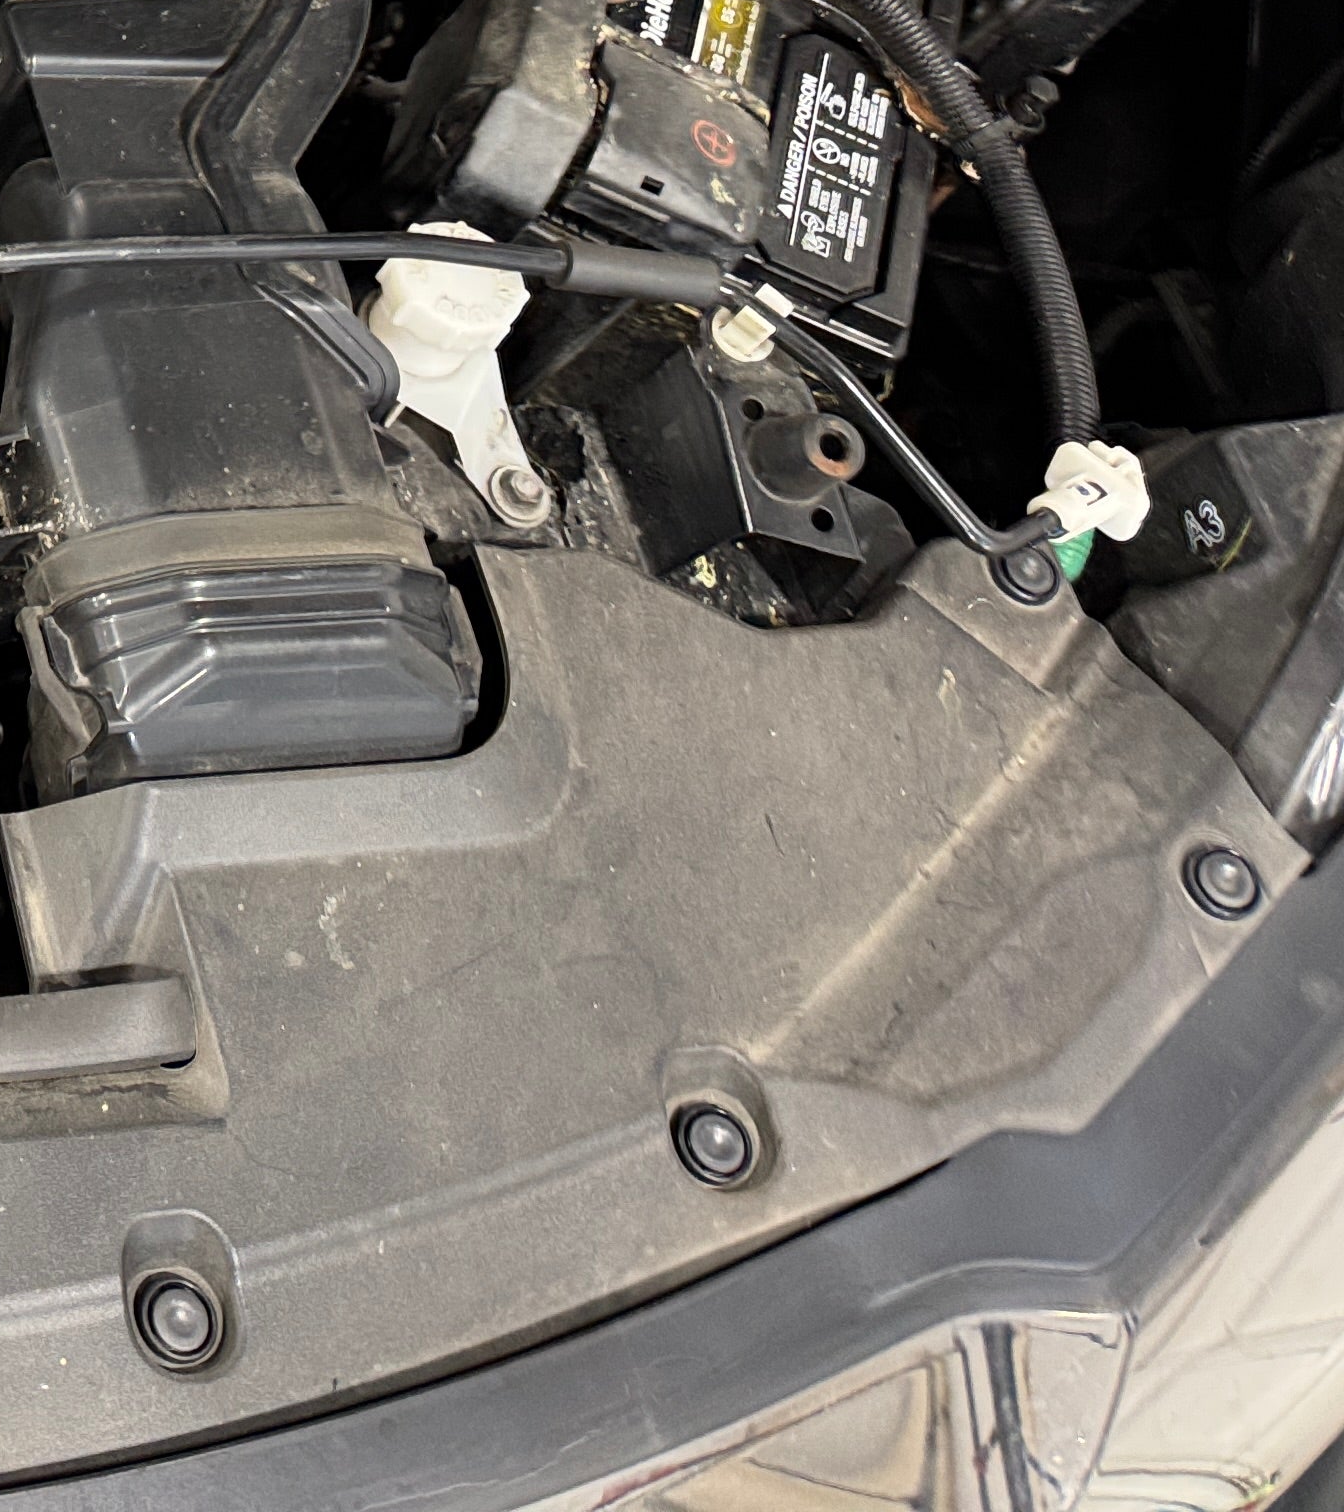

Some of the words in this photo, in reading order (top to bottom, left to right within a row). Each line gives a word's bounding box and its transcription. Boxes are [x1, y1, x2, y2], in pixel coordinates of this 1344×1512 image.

[779, 139, 807, 204] DANGER
[793, 72, 819, 131] POISON
[1183, 499, 1226, 555] A3
